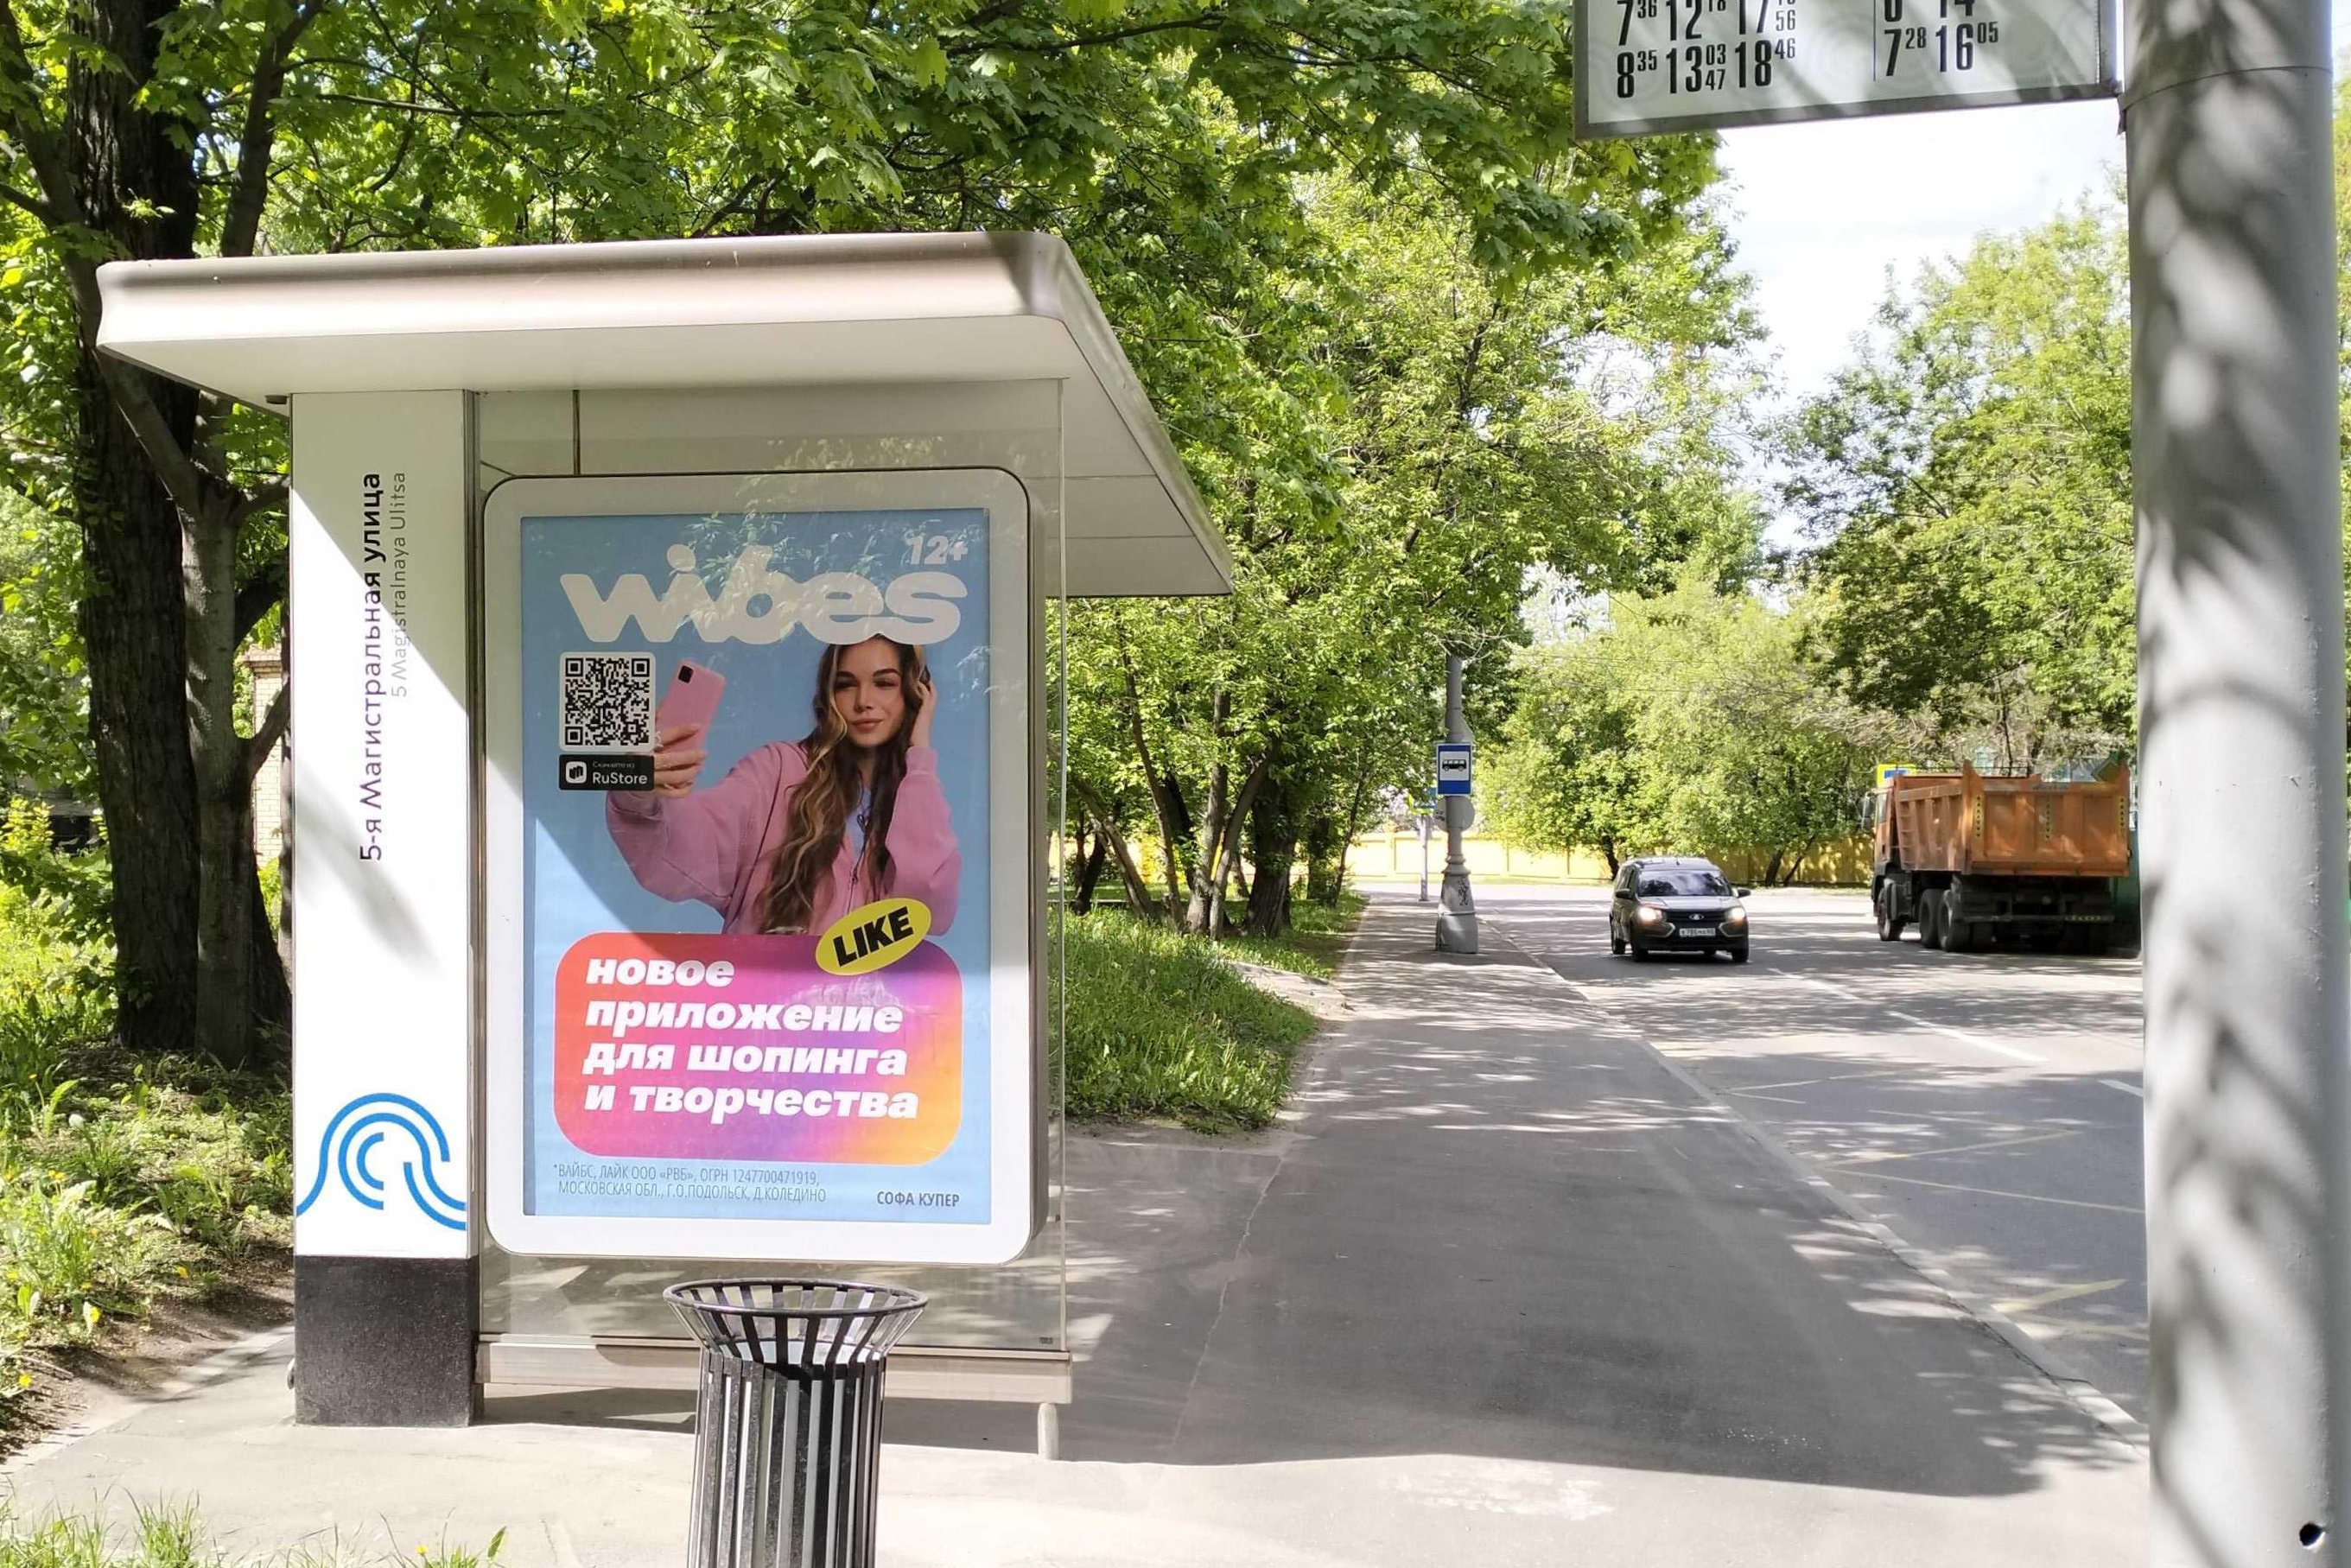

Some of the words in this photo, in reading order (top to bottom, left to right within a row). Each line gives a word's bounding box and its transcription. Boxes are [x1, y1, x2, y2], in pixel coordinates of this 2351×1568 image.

[1617, 0, 1634, 47] 7
[1637, 0, 1657, 18] 36
[1665, 0, 1702, 41] 12
[1776, 10, 1796, 32] 56
[1637, 50, 1657, 72] 35
[1706, 43, 1726, 66] 03
[1734, 40, 1771, 88] 18
[1775, 38, 1796, 60] 46
[1884, 29, 1902, 76] 7
[1905, 27, 1927, 49] 28
[1935, 23, 1974, 72] 16
[1977, 22, 1998, 44] 05
[1617, 52, 1635, 98] 8
[1665, 45, 1702, 94] 13
[1705, 69, 1726, 91] 47
[364, 473, 386, 563] улица
[389, 473, 406, 530] Ulitsa
[907, 536, 969, 565] 12+
[390, 536, 410, 681] Magistralnaya
[560, 543, 969, 645] wibes
[359, 572, 387, 810] Магистральная
[391, 685, 407, 697] 5
[593, 771, 648, 784] RuStore
[359, 819, 383, 860] 5-я
[833, 906, 914, 967] LIKE
[586, 958, 735, 988] новое
[584, 1000, 904, 1038] приложение
[581, 1042, 677, 1076] для
[686, 1044, 909, 1076] шопинга
[583, 1084, 617, 1112] и
[628, 1086, 919, 1125] творчества
[558, 1180, 632, 1196] МОСКОВСКАЯ
[635, 1183, 664, 1198] ОБЛ.,
[600, 1164, 629, 1178] ЛАЙК
[631, 1165, 657, 1180] ООО
[659, 1166, 696, 1182] «РВБ»,
[700, 1168, 728, 1183] ОГРН
[734, 1169, 820, 1187] 1247700471919,
[876, 1190, 915, 1206] СОФА
[918, 1192, 960, 1208] КУПЕР
